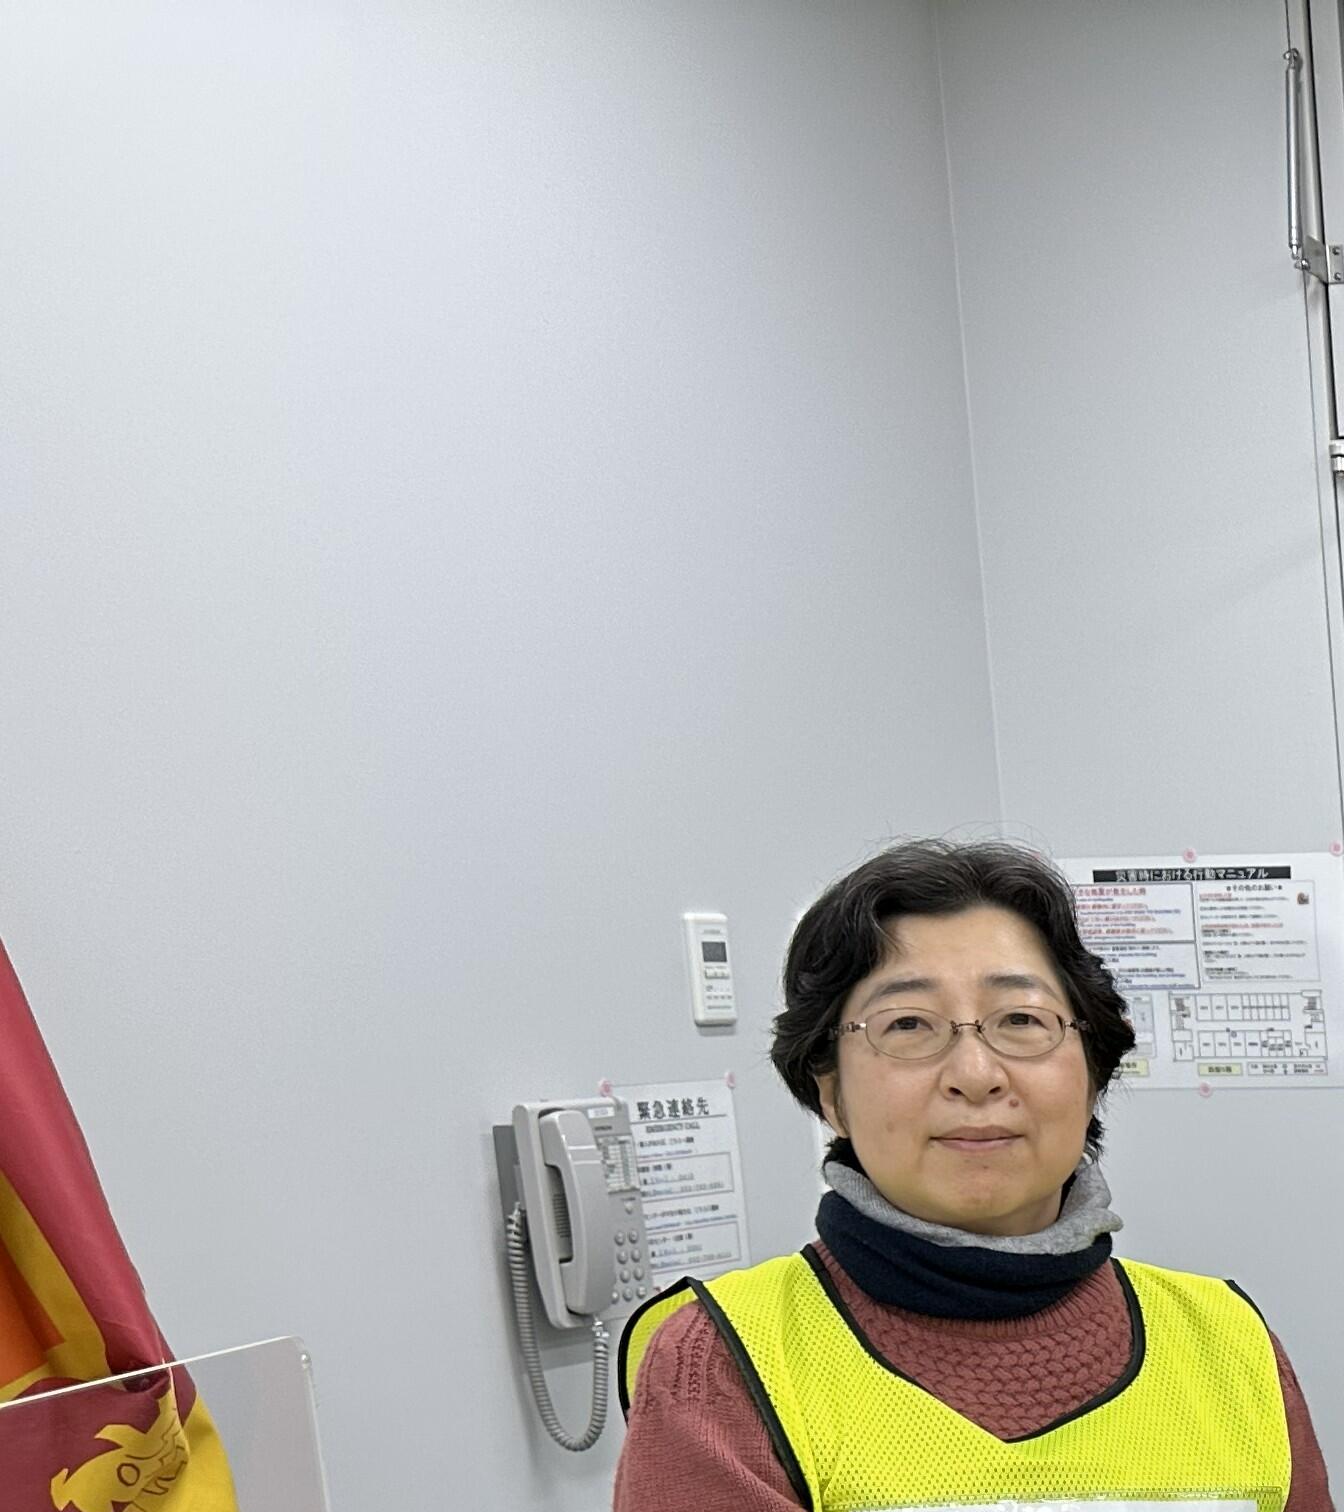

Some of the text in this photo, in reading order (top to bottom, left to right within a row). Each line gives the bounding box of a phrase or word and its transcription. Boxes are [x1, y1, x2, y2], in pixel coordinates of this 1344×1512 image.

[1116, 867, 1269, 882] 災害時における行動マニュアル
[637, 1096, 709, 1120] 緊急連絡先
